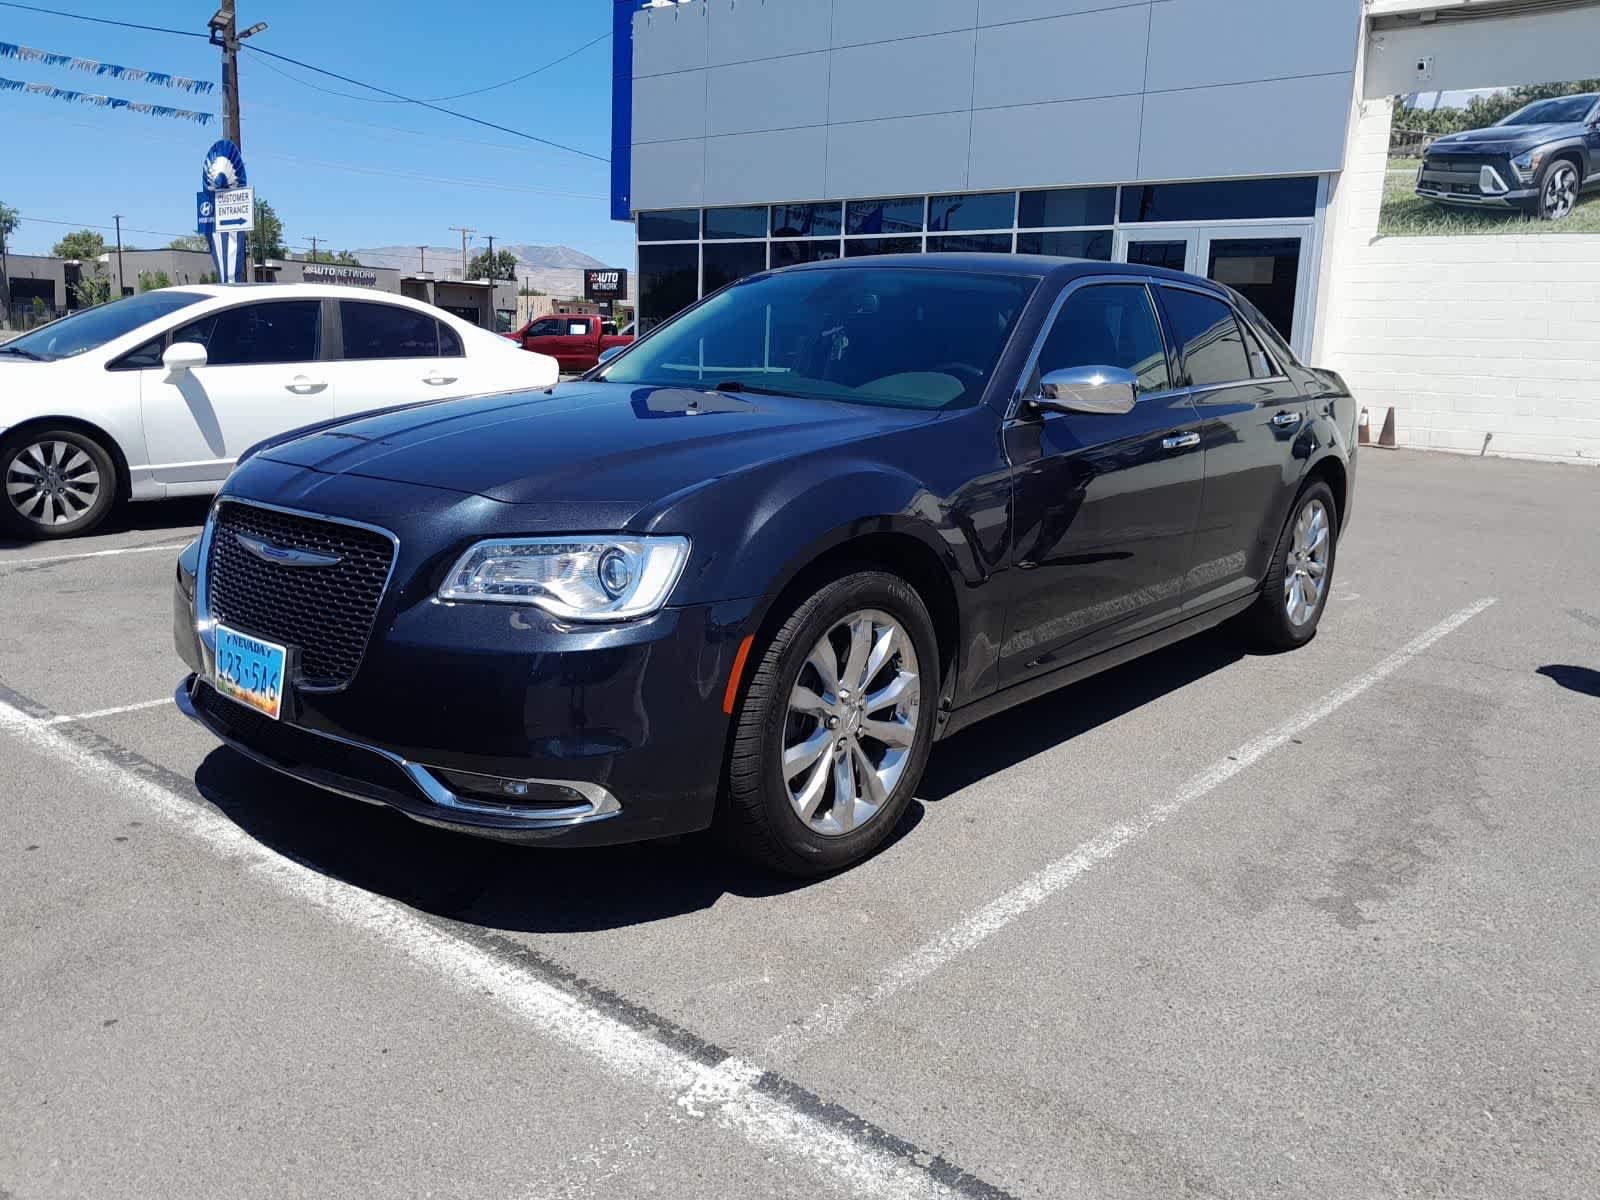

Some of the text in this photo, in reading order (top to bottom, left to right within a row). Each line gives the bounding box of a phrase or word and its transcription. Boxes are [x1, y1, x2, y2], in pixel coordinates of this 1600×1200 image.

[218, 192, 249, 204] CUSTOMER
[218, 205, 249, 217] ENTRANCE
[312, 265, 376, 279] AUTO NETWORK
[597, 272, 619, 283] AUTO
[232, 635, 265, 657] NEVADA
